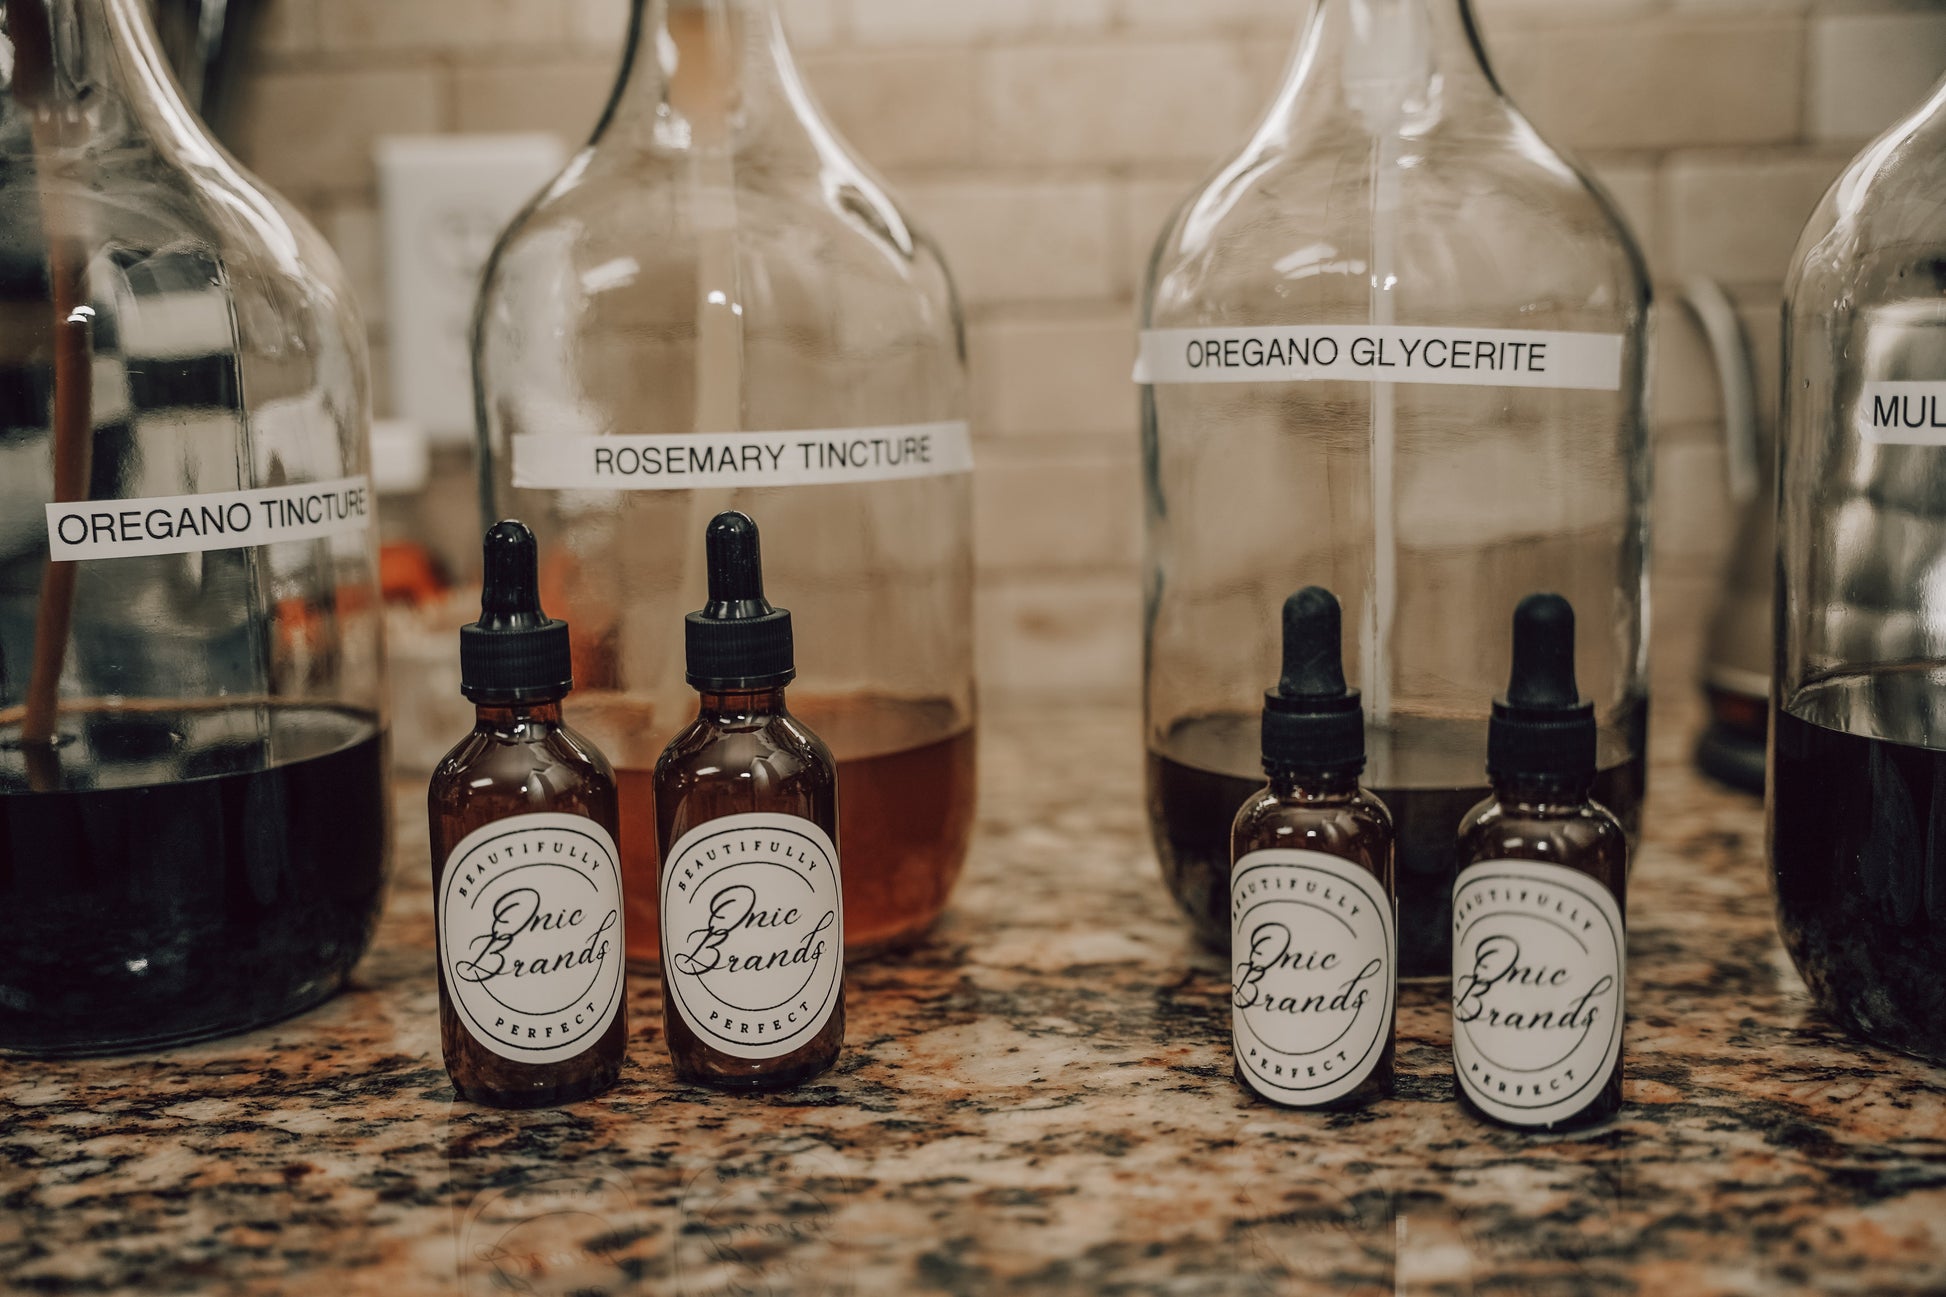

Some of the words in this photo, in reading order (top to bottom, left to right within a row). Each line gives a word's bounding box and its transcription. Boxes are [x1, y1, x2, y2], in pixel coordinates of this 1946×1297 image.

[1186, 337, 1339, 370] OREGANO
[1350, 338, 1547, 373] GLYCERITE
[595, 444, 785, 475] ROSEMARY
[797, 435, 932, 468] TINCTURE
[57, 502, 252, 546] OREGANO
[260, 487, 367, 529] TINCTURE
[459, 841, 600, 898] BEAUTIFULLY
[678, 840, 817, 892] BEAUTIFULLY
[456, 909, 618, 983] Brands
[674, 910, 835, 976] Brands
[1231, 958, 1382, 1014] Brands
[1452, 975, 1614, 1030] Brands
[494, 1002, 597, 1038] PERFECT
[709, 1001, 808, 1034] PERFECT
[1249, 1048, 1347, 1079] PERFECT
[1471, 1062, 1576, 1097] PERFECT
